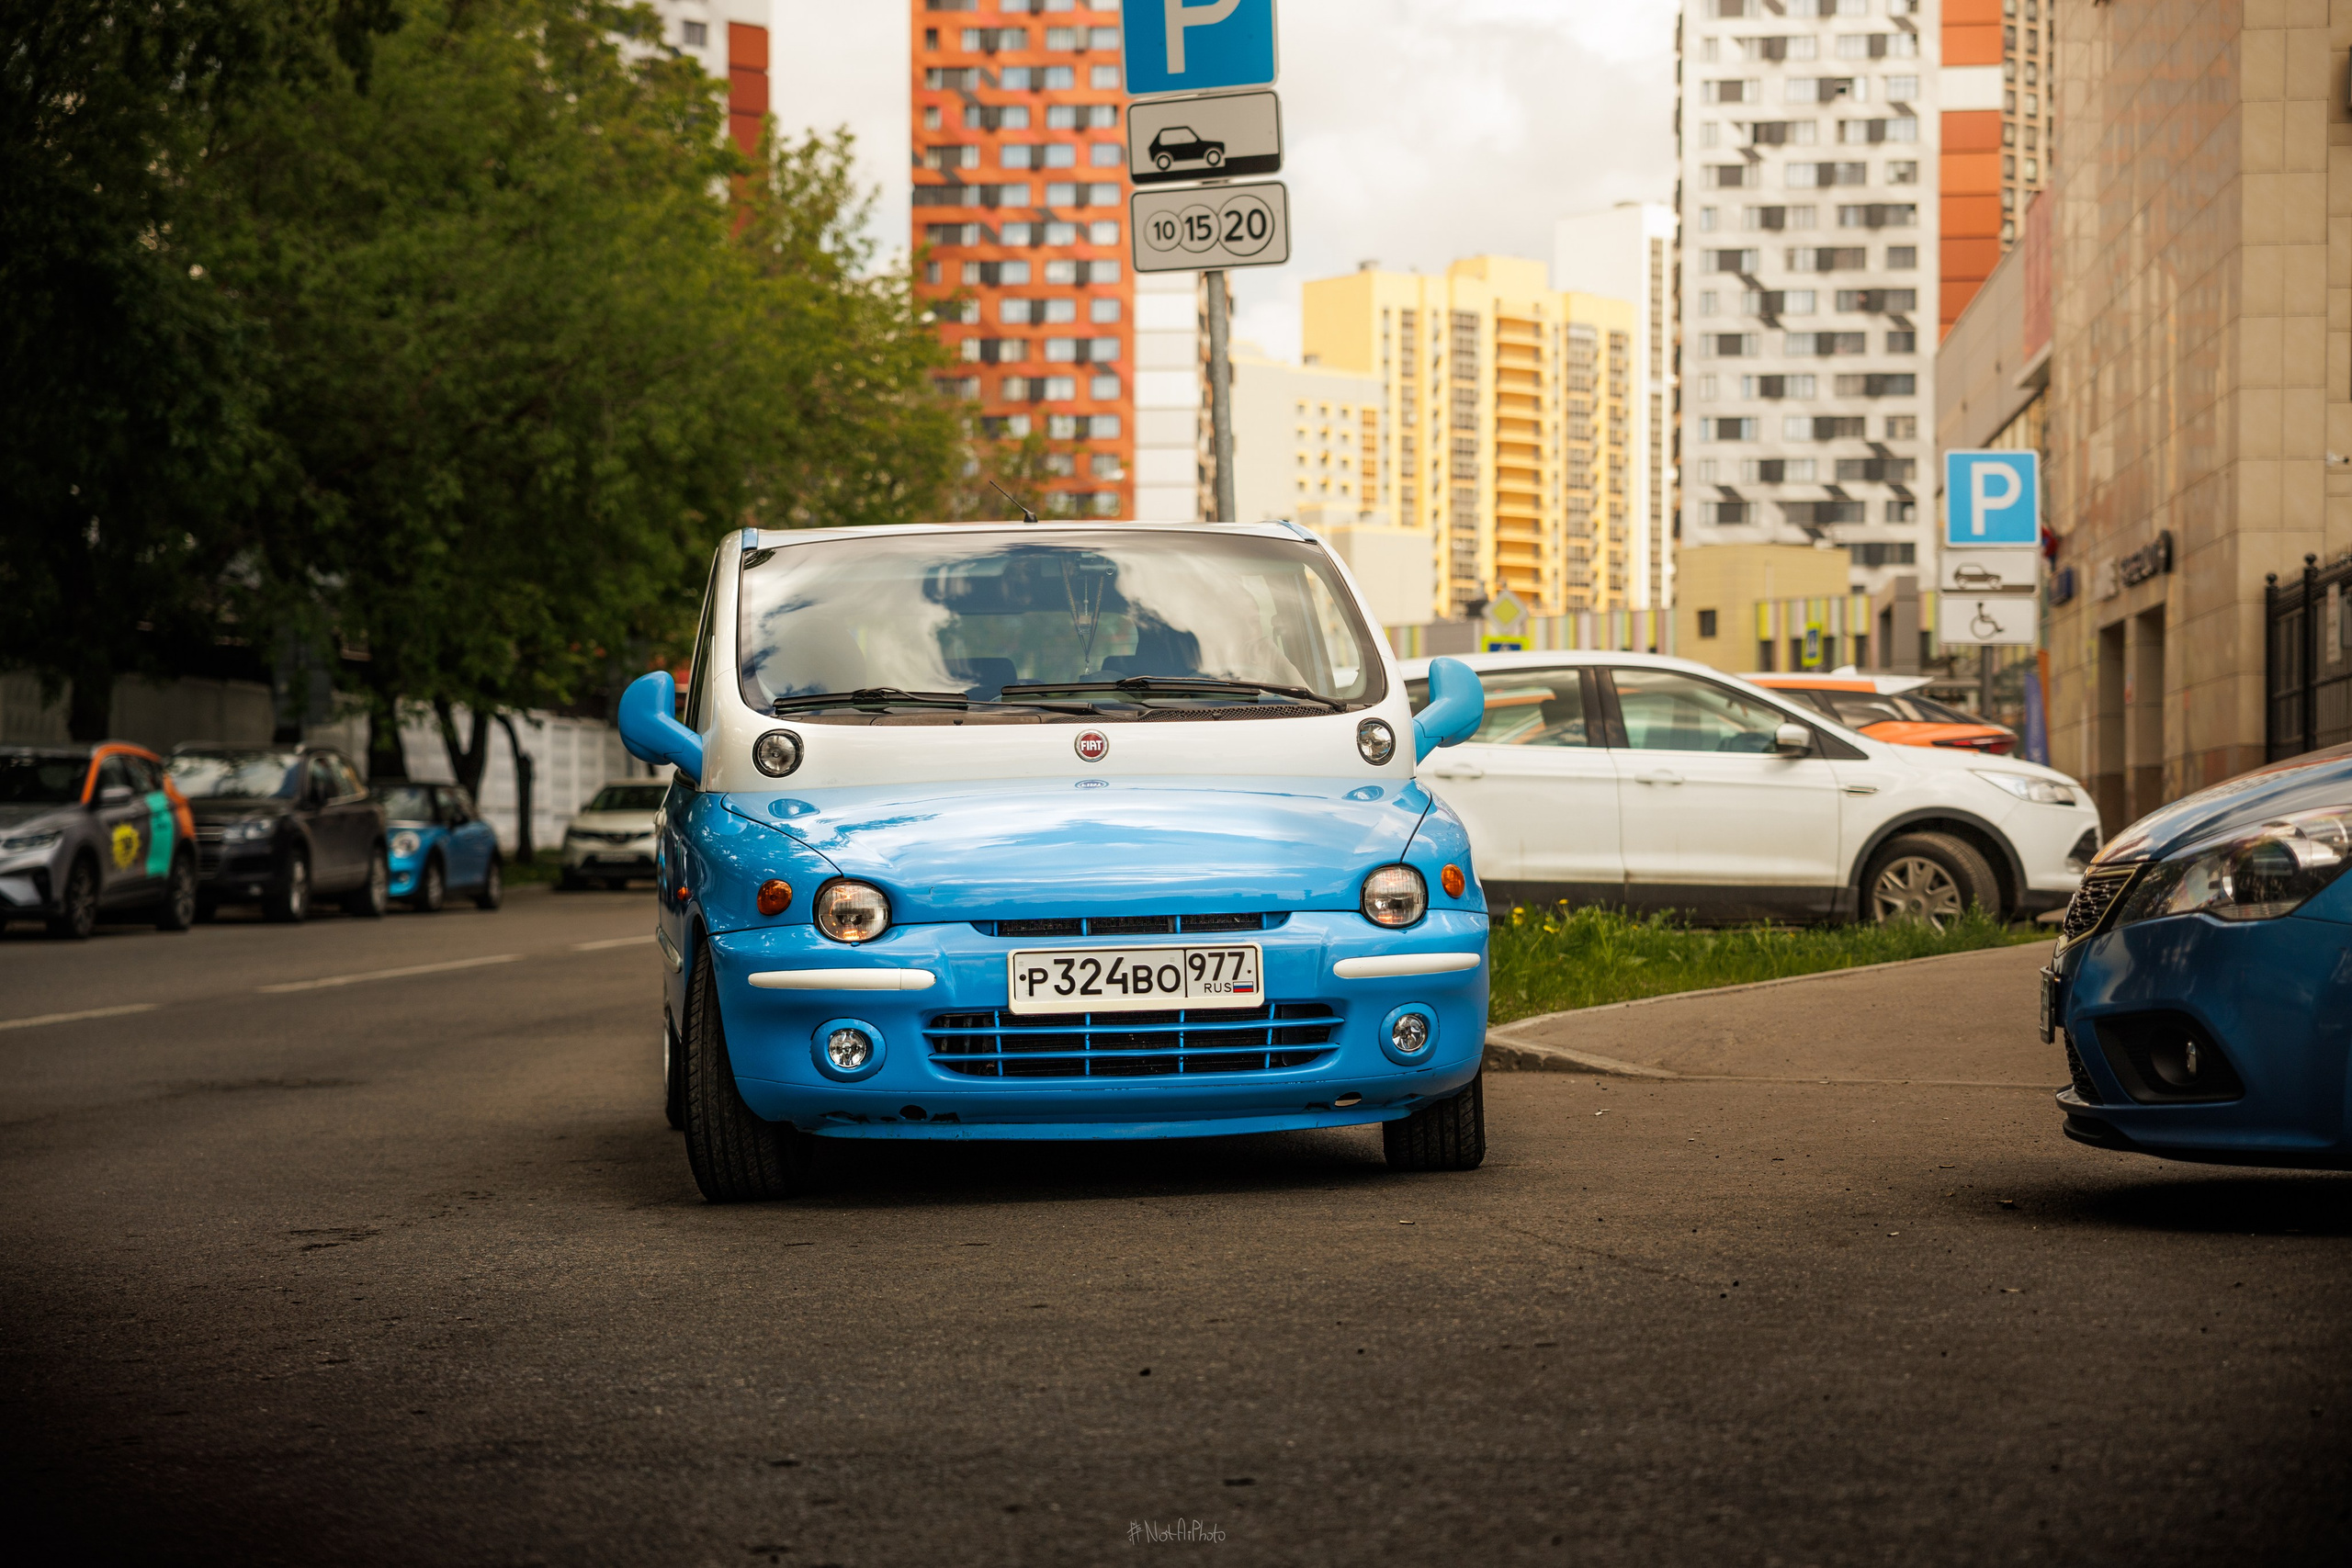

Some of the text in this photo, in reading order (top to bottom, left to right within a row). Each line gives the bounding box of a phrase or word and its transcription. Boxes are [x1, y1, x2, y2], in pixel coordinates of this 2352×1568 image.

[1164, 0, 1241, 74] P
[1153, 208, 1267, 243] 10 15 20
[1971, 461, 2022, 536] P
[1080, 739, 1102, 751] FIAT
[1188, 951, 1246, 982] 977
[1204, 982, 1232, 993] RUS
